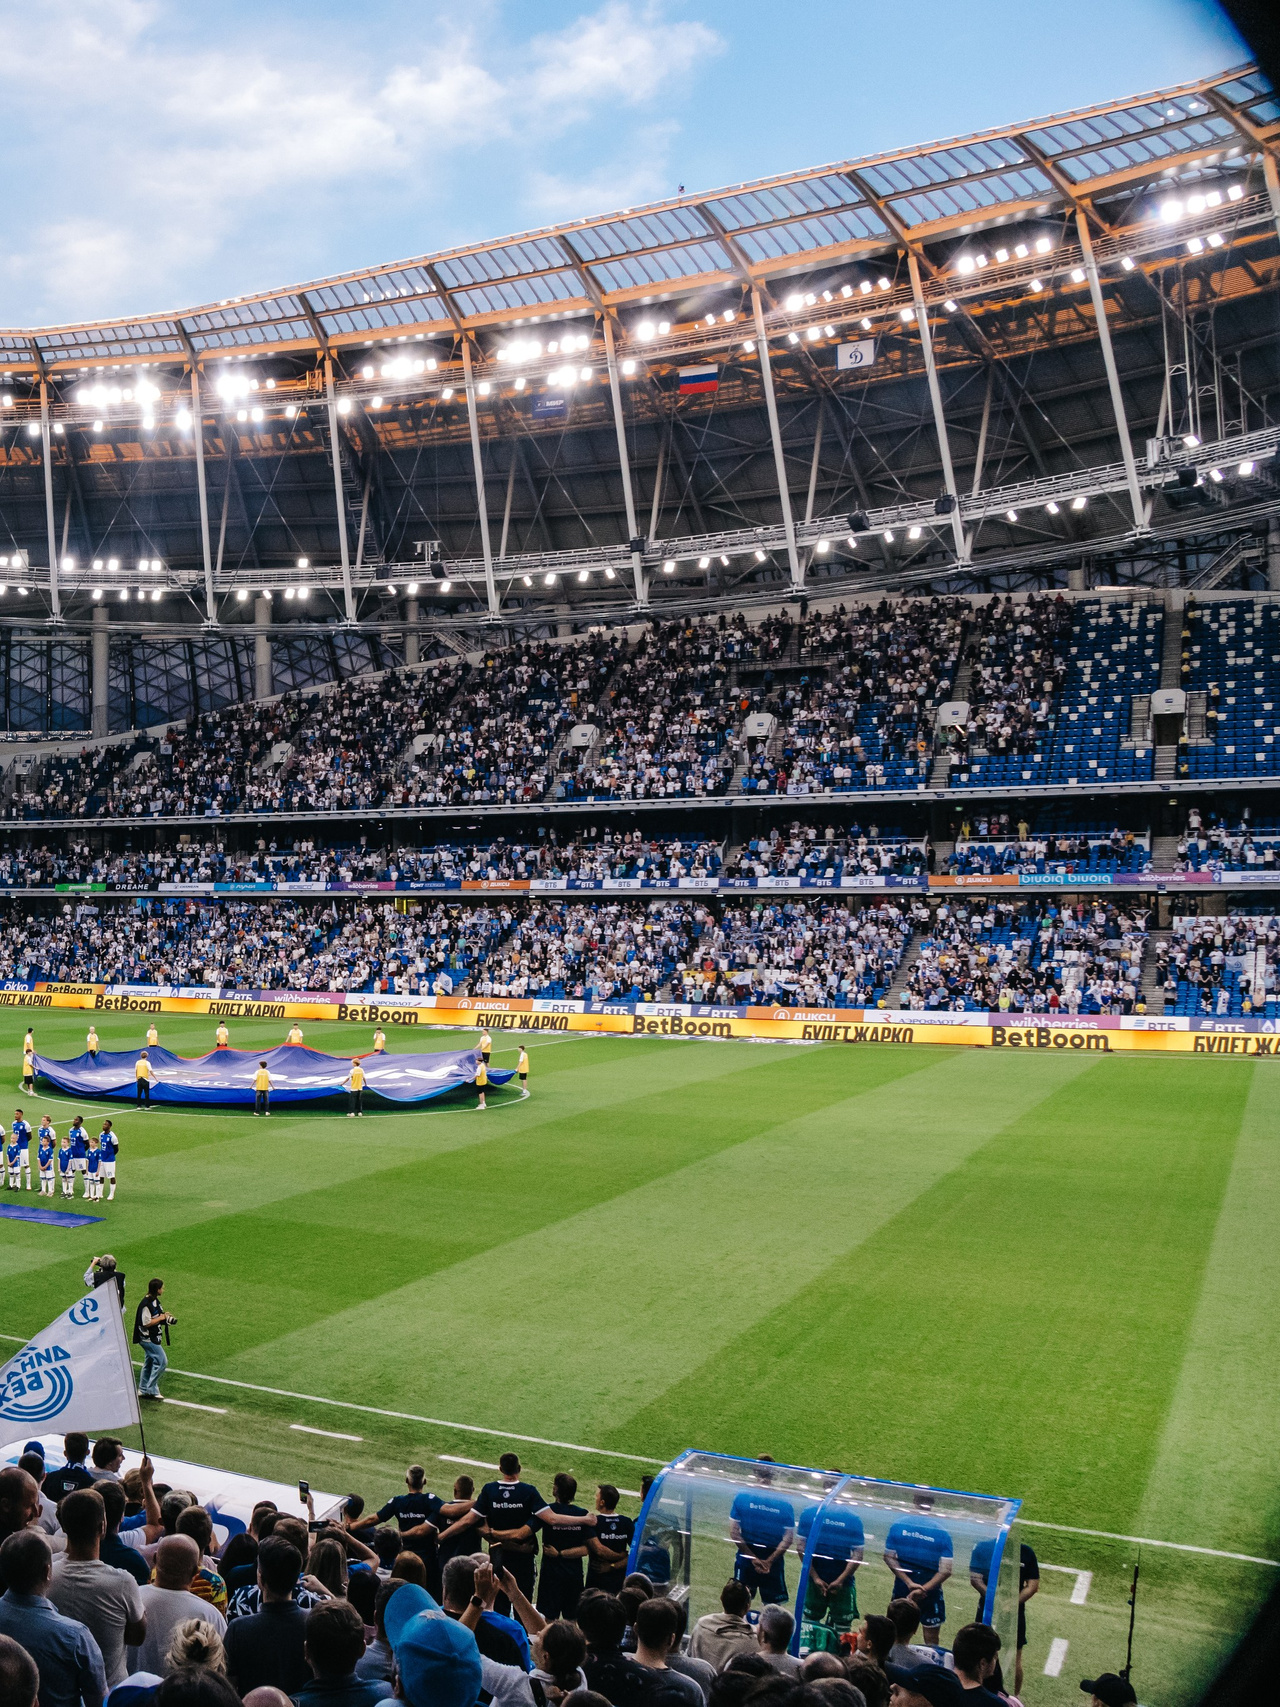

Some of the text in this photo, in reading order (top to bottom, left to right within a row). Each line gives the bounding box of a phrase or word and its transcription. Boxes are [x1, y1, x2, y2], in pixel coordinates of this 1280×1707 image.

[1138, 874, 1186, 882] wildberries
[46, 984, 93, 994] BetBoom
[95, 994, 161, 1012] BetBoom
[273, 994, 331, 1003] wildberries
[338, 1004, 418, 1024] BetBoom
[633, 1015, 731, 1036] BetBoom
[1010, 1015, 1098, 1029] wildberries
[992, 1026, 1109, 1049] BetBoom
[492, 1501, 524, 1509] BetBoom
[749, 1502, 781, 1514] BetBoom
[901, 1529, 935, 1543] BetBoom
